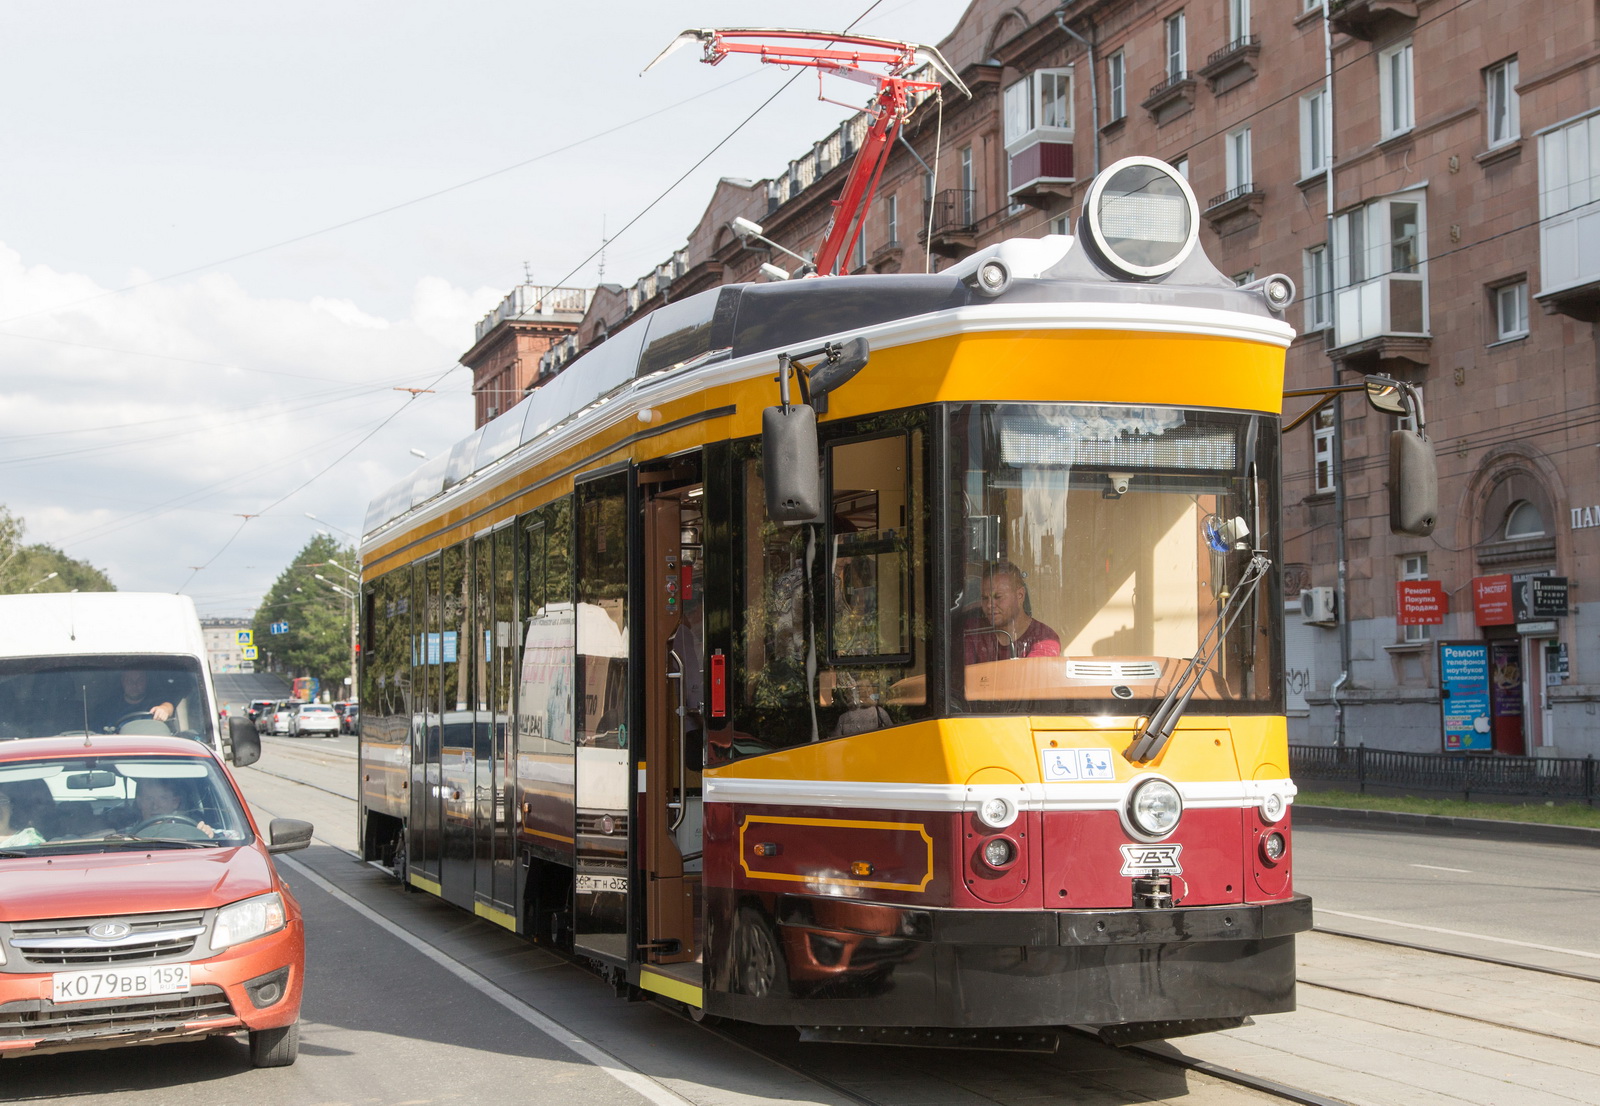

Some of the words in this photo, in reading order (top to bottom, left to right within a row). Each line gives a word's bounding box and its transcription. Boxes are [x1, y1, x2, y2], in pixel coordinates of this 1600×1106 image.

[1405, 596, 1436, 604] Покупка
[1405, 604, 1439, 612] Продажа
[1445, 648, 1484, 657] Ремонт
[1446, 666, 1483, 674] ноутбуков
[1129, 849, 1175, 867] УВЗ
[61, 973, 147, 997] К079ВВ
[153, 967, 184, 983] 159
